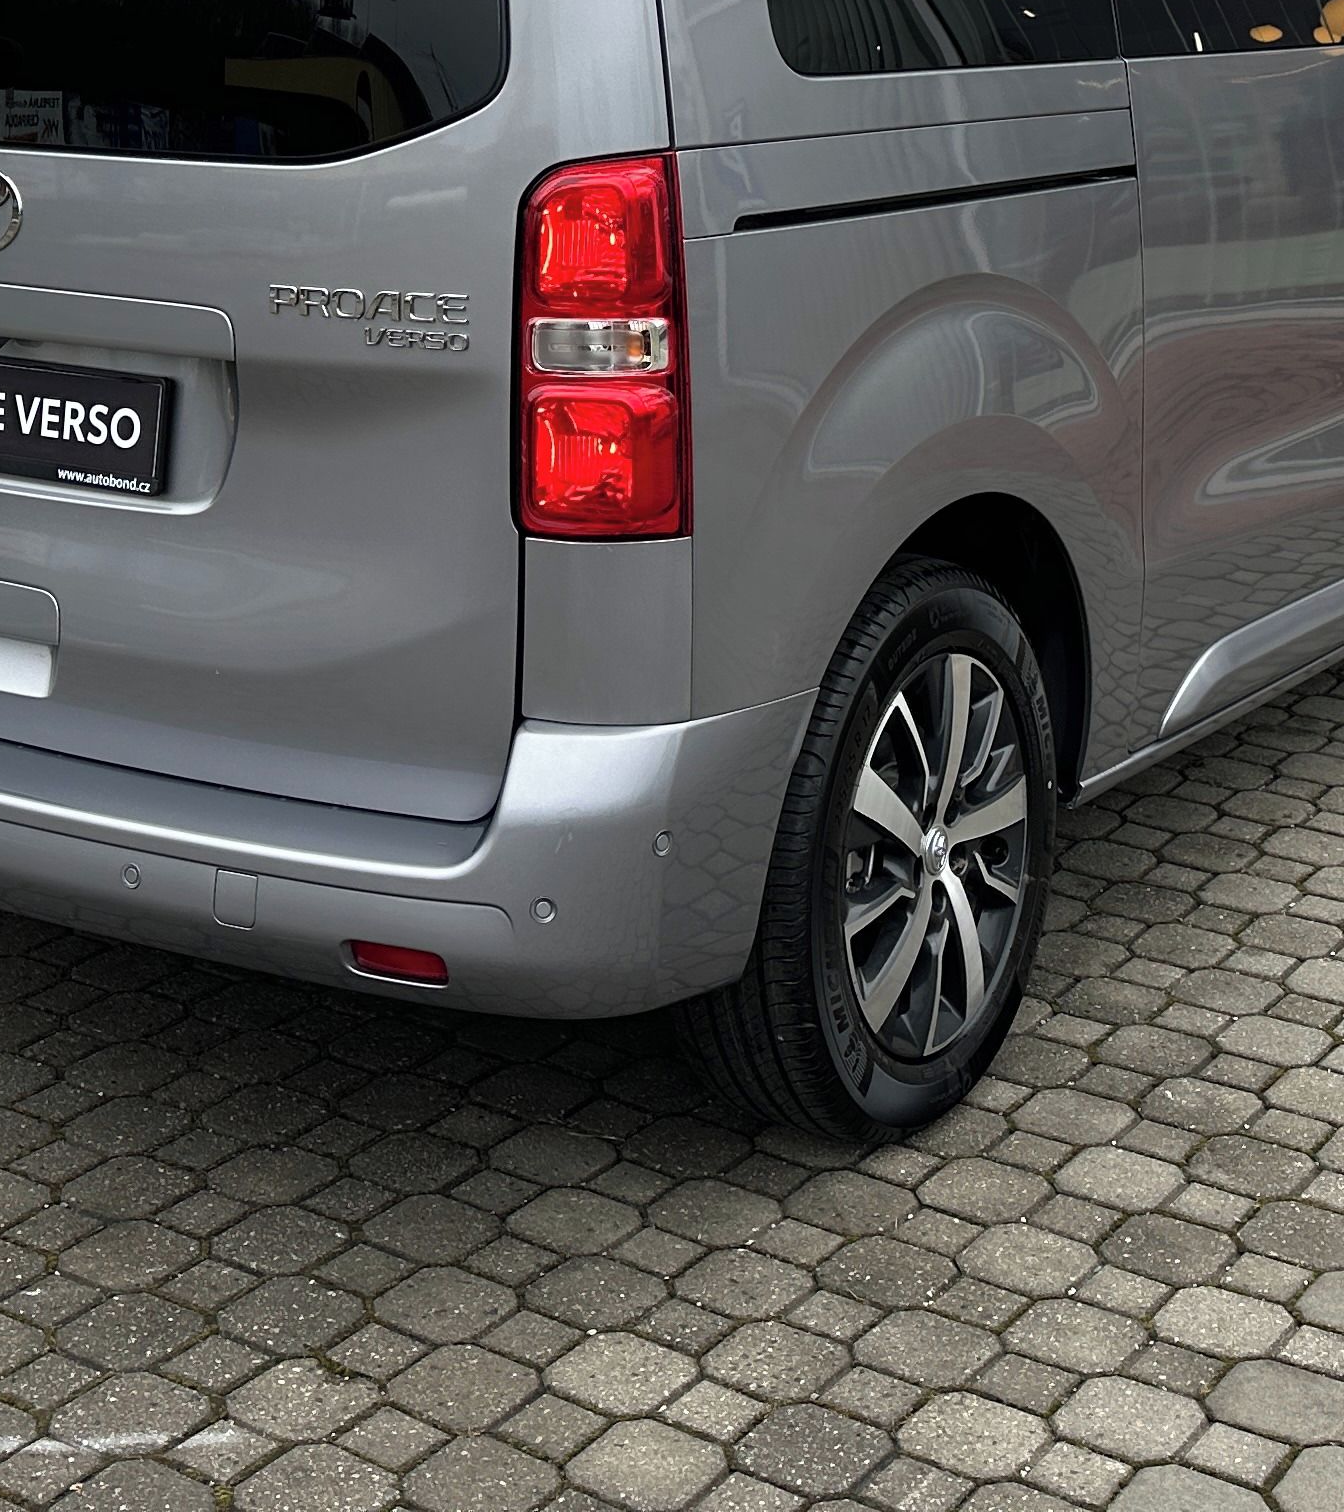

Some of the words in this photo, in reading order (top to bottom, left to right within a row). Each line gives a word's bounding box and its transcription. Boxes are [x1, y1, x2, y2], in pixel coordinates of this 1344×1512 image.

[268, 283, 471, 325] PROACE
[363, 326, 470, 352] VERSO
[14, 393, 142, 450] VERSO
[57, 468, 152, 494] www.autobond.cz
